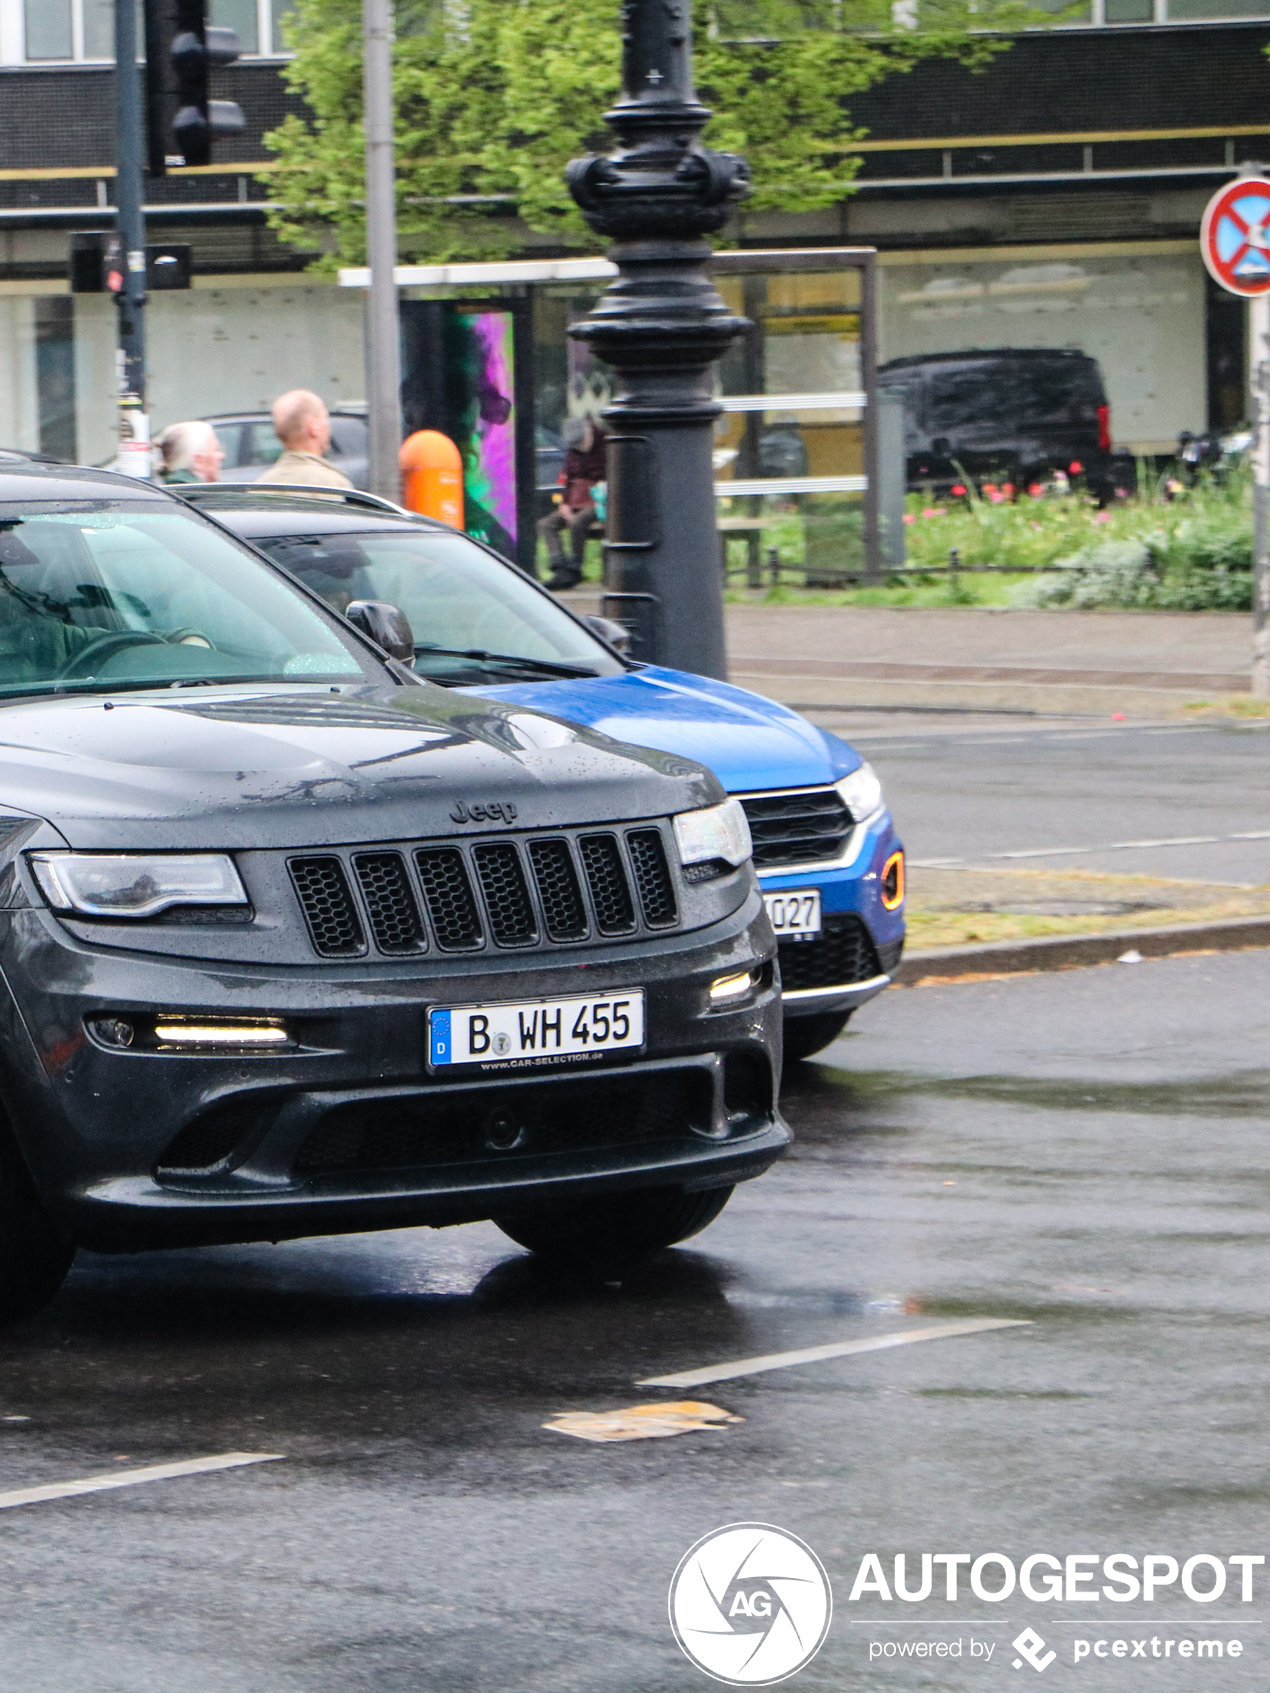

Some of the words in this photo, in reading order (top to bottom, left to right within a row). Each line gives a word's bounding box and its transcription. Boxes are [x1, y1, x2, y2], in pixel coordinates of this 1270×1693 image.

[449, 800, 518, 825] Jeep
[773, 896, 814, 929] 027
[468, 1014, 491, 1055] B
[518, 1007, 561, 1050] WH
[571, 1000, 631, 1045] 455
[436, 1042, 446, 1055] D
[481, 1052, 604, 1071] www.CAR-SELECTION.de
